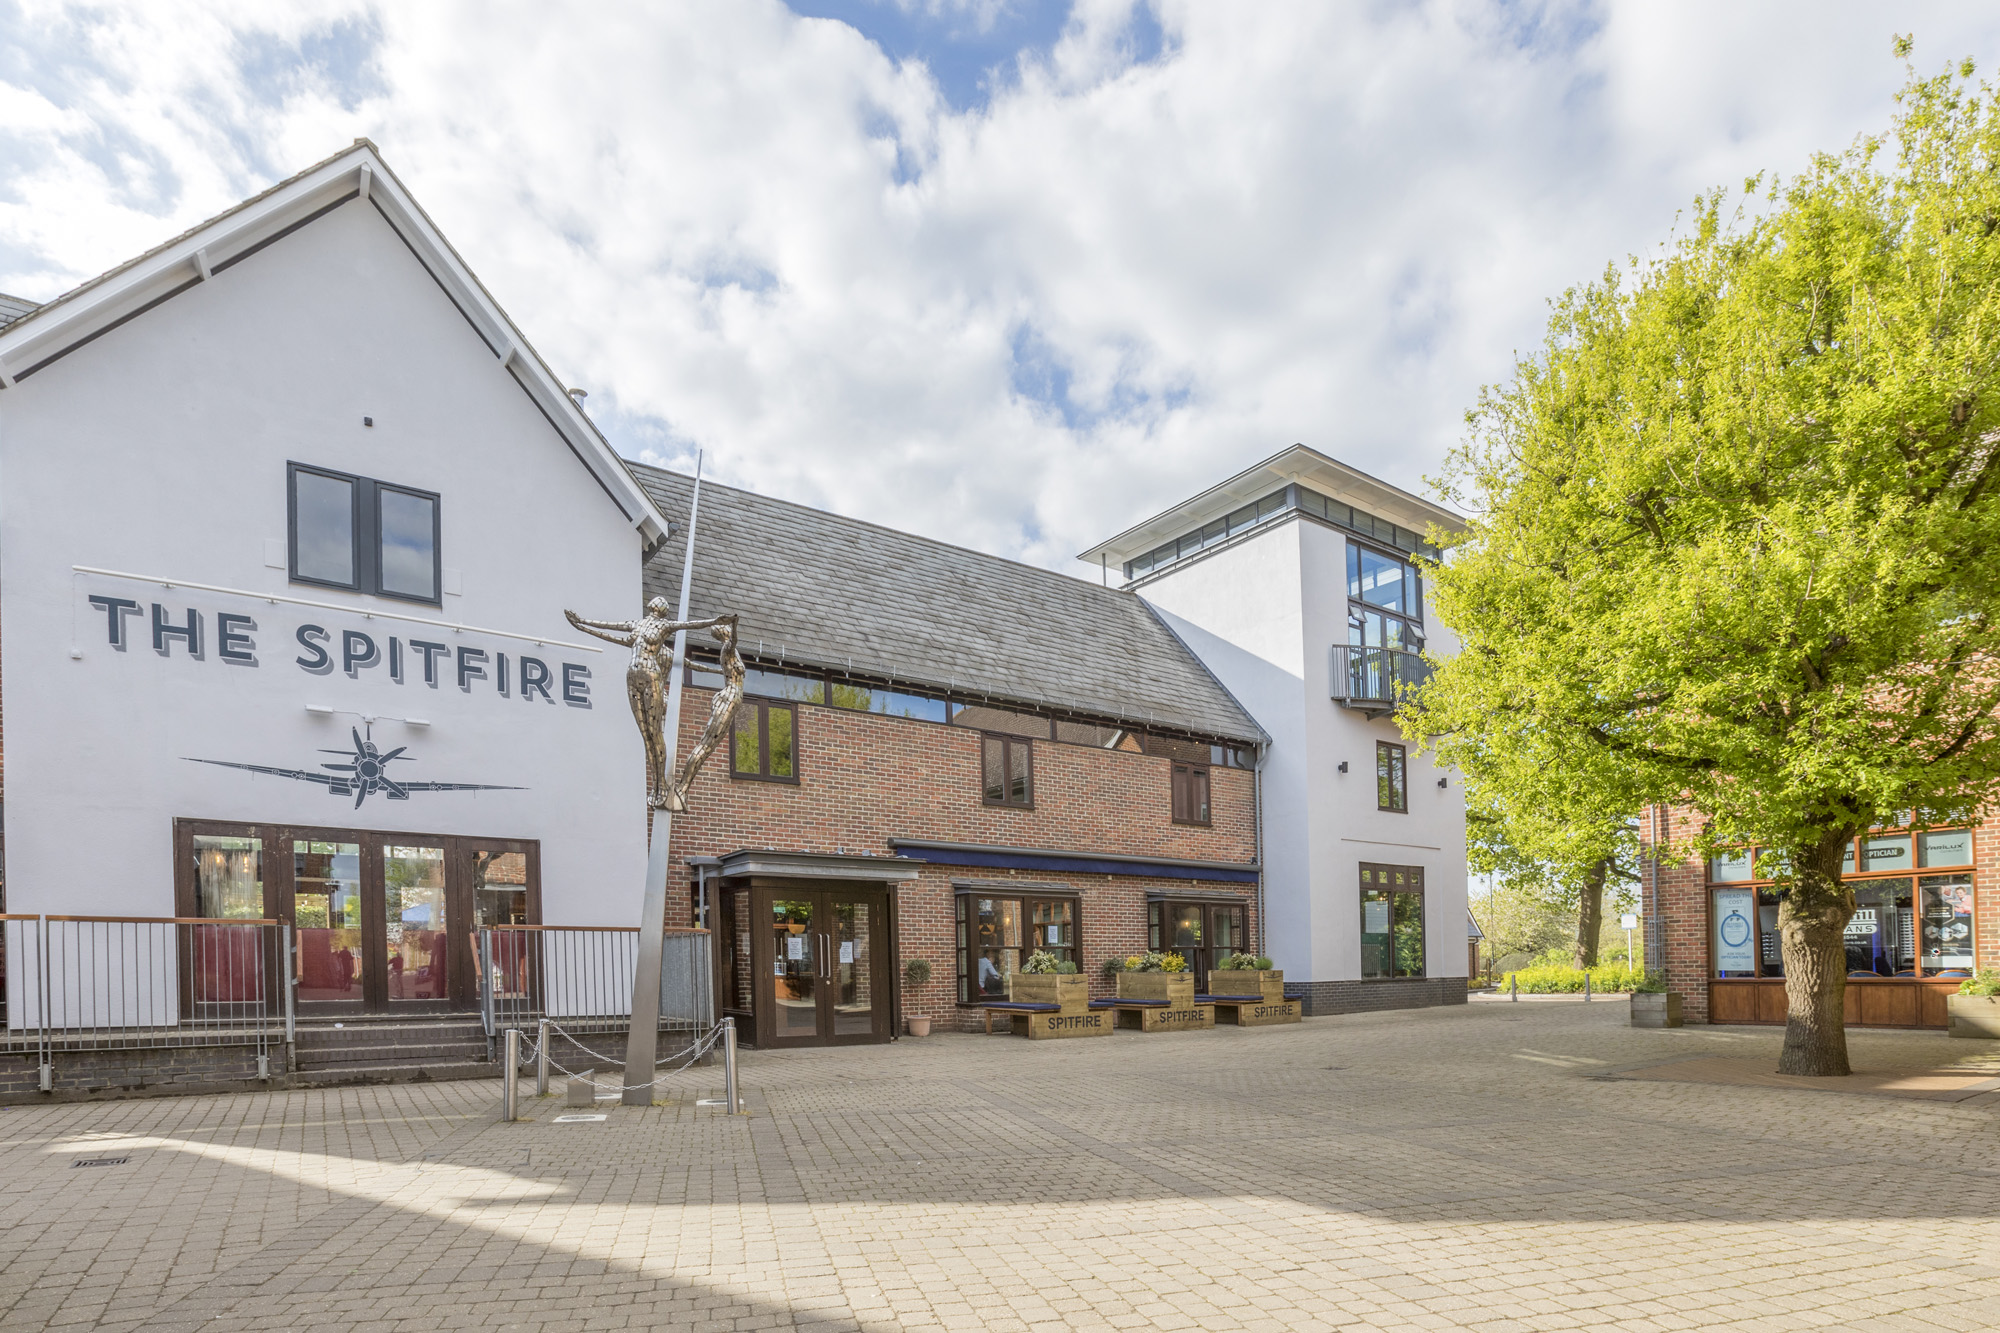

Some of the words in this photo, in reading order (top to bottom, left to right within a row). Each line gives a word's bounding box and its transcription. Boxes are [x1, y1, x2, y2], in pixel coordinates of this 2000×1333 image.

[88, 595, 258, 667] THE
[296, 623, 593, 709] SPITFIRE
[1864, 849, 1897, 858] OPTICIAN
[1159, 1009, 1205, 1023] SPITFIRE
[1254, 1005, 1293, 1018] SPITFIRE
[1048, 1015, 1101, 1030] SPITFIRE
